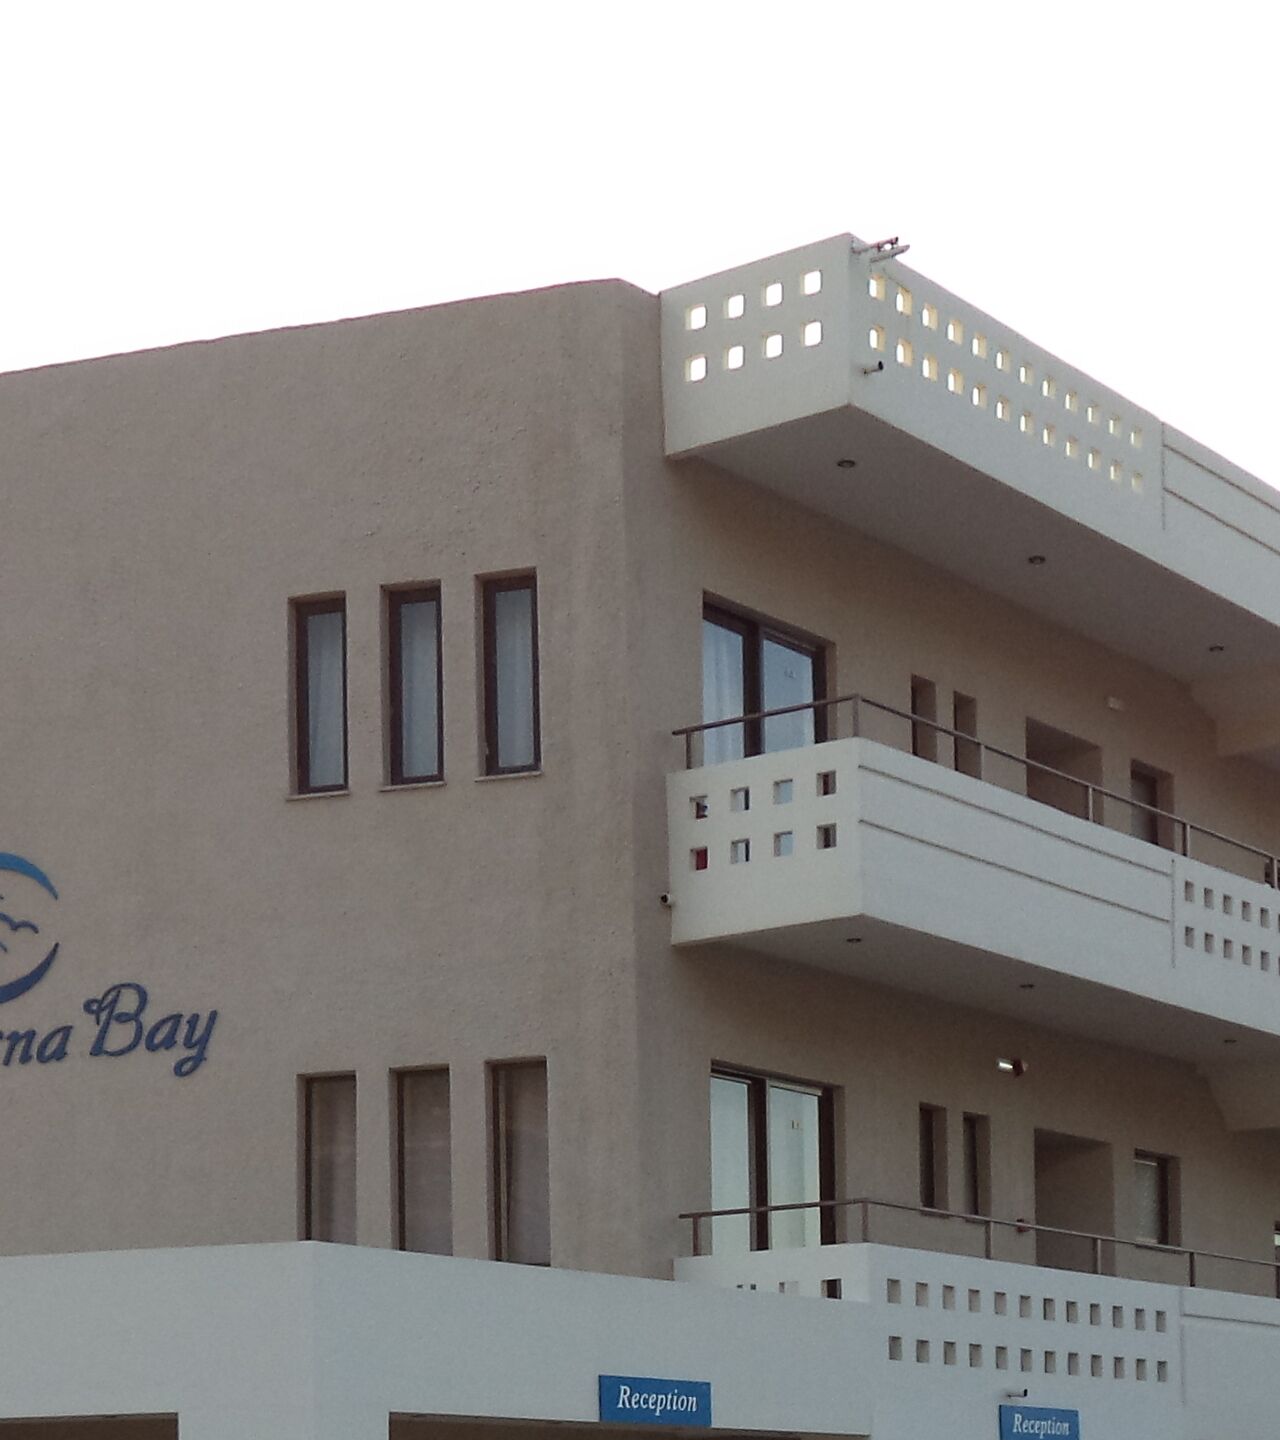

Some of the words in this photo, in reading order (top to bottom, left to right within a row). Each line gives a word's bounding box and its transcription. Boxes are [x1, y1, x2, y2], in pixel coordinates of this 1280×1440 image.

[82, 982, 219, 1078] Bay
[617, 1385, 698, 1416] Reception
[1012, 1413, 1070, 1440] Reception
